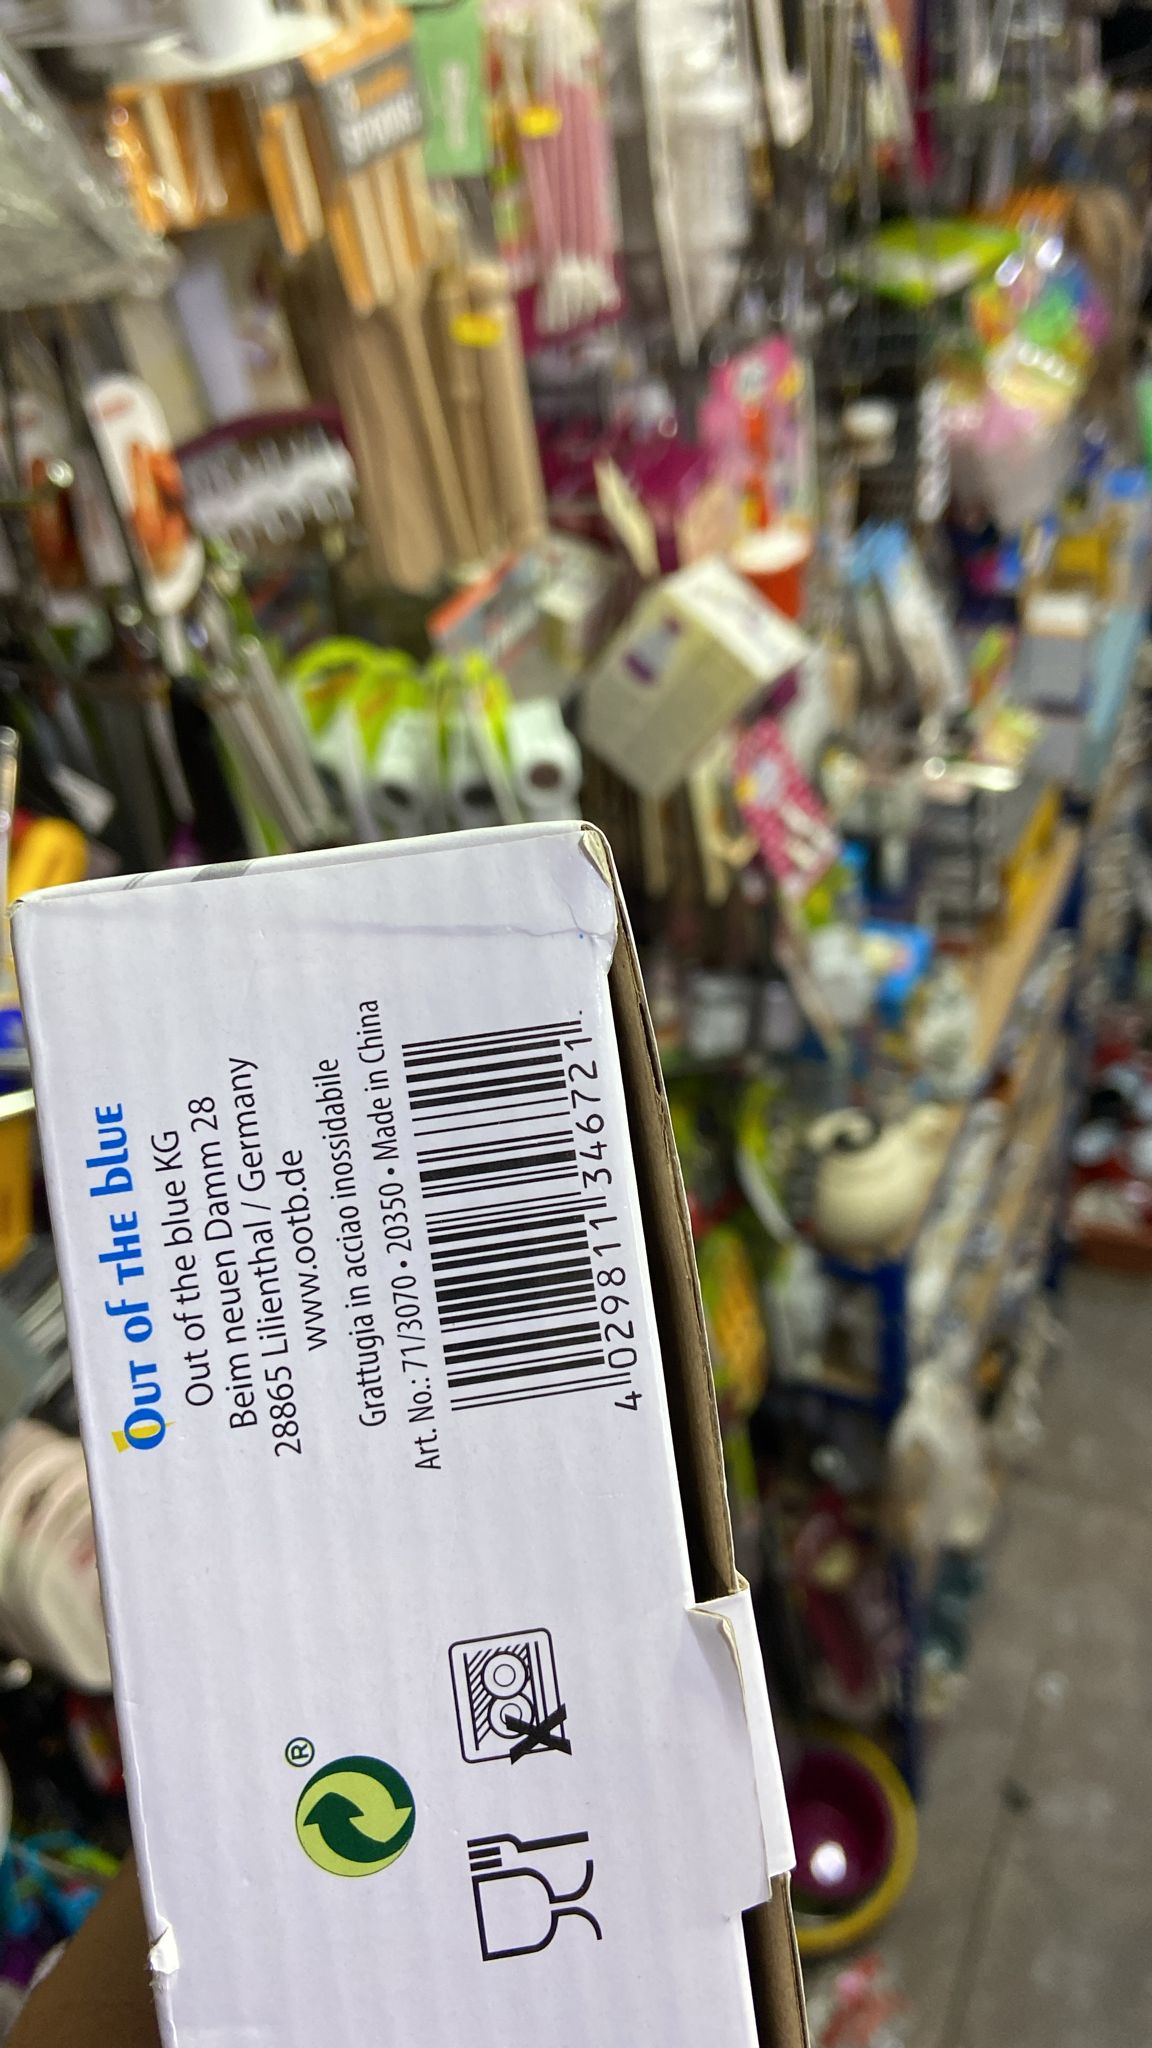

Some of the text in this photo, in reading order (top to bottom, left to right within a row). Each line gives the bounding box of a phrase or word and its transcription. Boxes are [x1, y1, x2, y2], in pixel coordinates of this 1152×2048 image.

[356, 1000, 385, 1063] China
[229, 1058, 265, 1191] Germany
[364, 1070, 389, 1091] in
[367, 1097, 399, 1160] Made
[188, 1097, 257, 1428] Beim neuen Damm 28
[276, 1150, 327, 1351] www.ootb.de
[312, 1059, 386, 1426] Grattugia in acciao inossidabile
[378, 1183, 412, 1254] 20350
[151, 1131, 213, 1406] Out of the blue KG
[243, 1221, 288, 1357] Lilienthal
[391, 1276, 428, 1373] 71/3070
[264, 1366, 302, 1457] 28865
[408, 1378, 435, 1423] No.:
[414, 1428, 441, 1469] Art.
